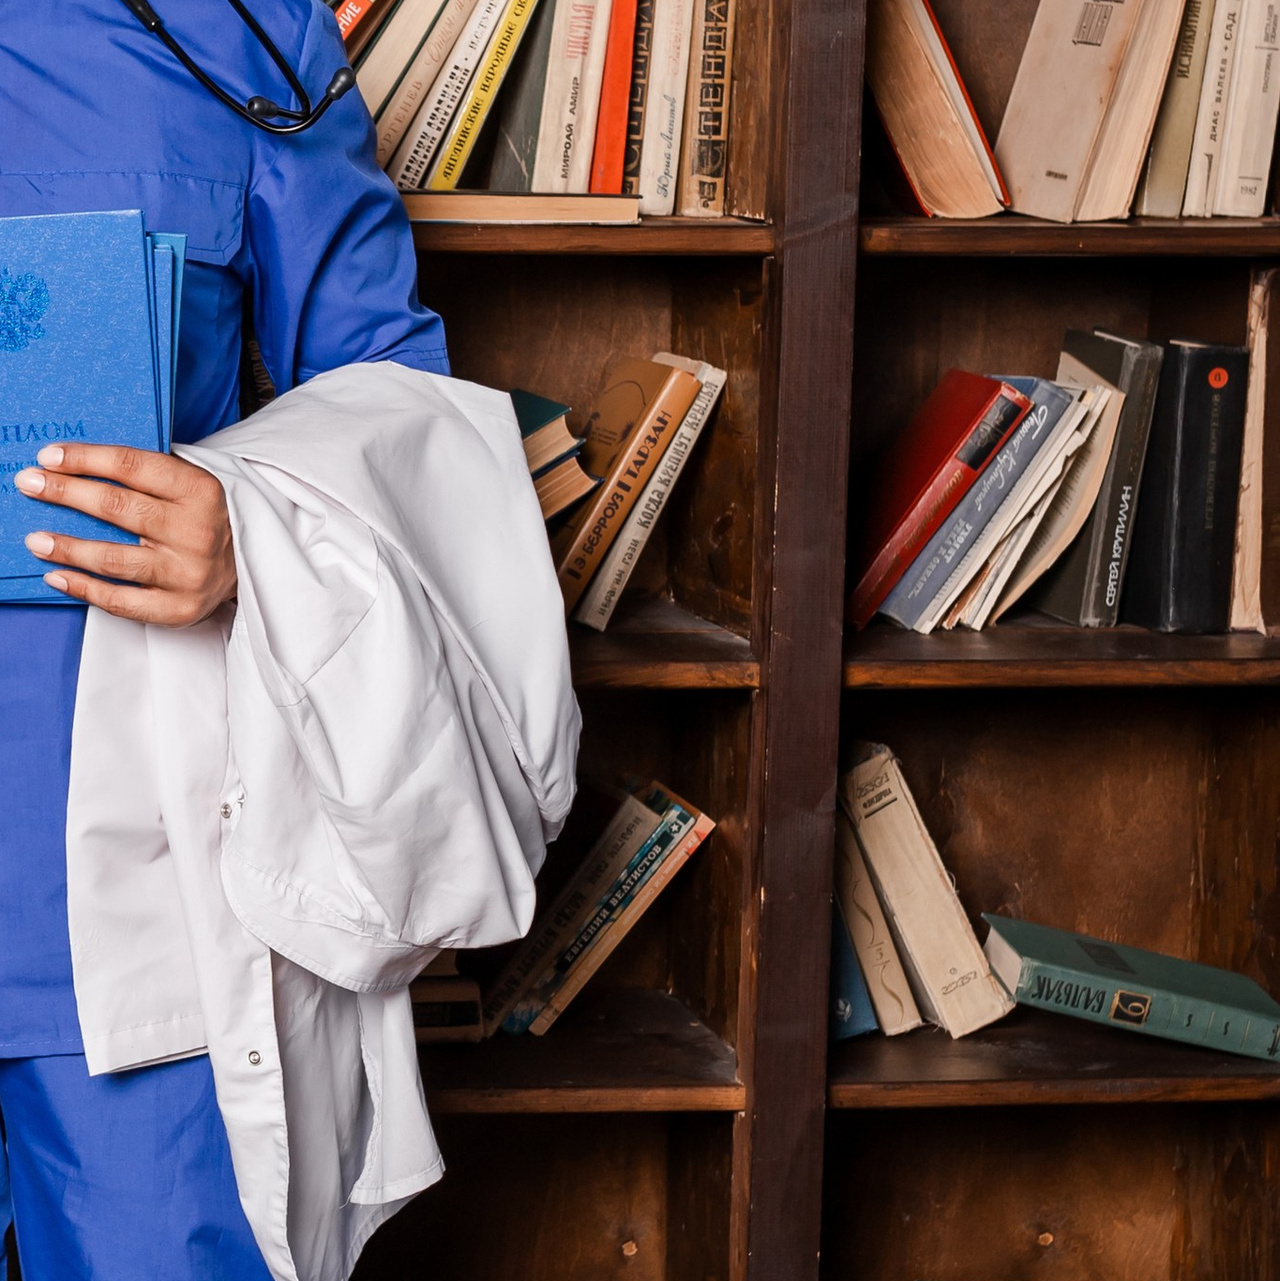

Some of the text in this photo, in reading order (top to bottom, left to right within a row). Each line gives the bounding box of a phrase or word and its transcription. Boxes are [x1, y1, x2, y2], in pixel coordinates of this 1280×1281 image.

[565, 2, 594, 60] ЧИСТАЯ
[440, 96, 484, 180] АНГЛИЙСКИЕ
[478, 20, 518, 93] НАРОДНЫЕ
[568, 75, 580, 115] АМИР
[1209, 11, 1236, 141] ДИАС ВАЛЕЕВ САД
[657, 151, 674, 197] Юрий
[622, 409, 672, 481] ТАРЗАН
[1104, 484, 1132, 606] СЕРГЕЙ КРУТИЛИН
[564, 907, 610, 962] ЕВГЕНИЙ
[608, 842, 663, 907] ВЕЛТИСТОВ
[1030, 974, 1106, 1014] БАЛЬЗАК
